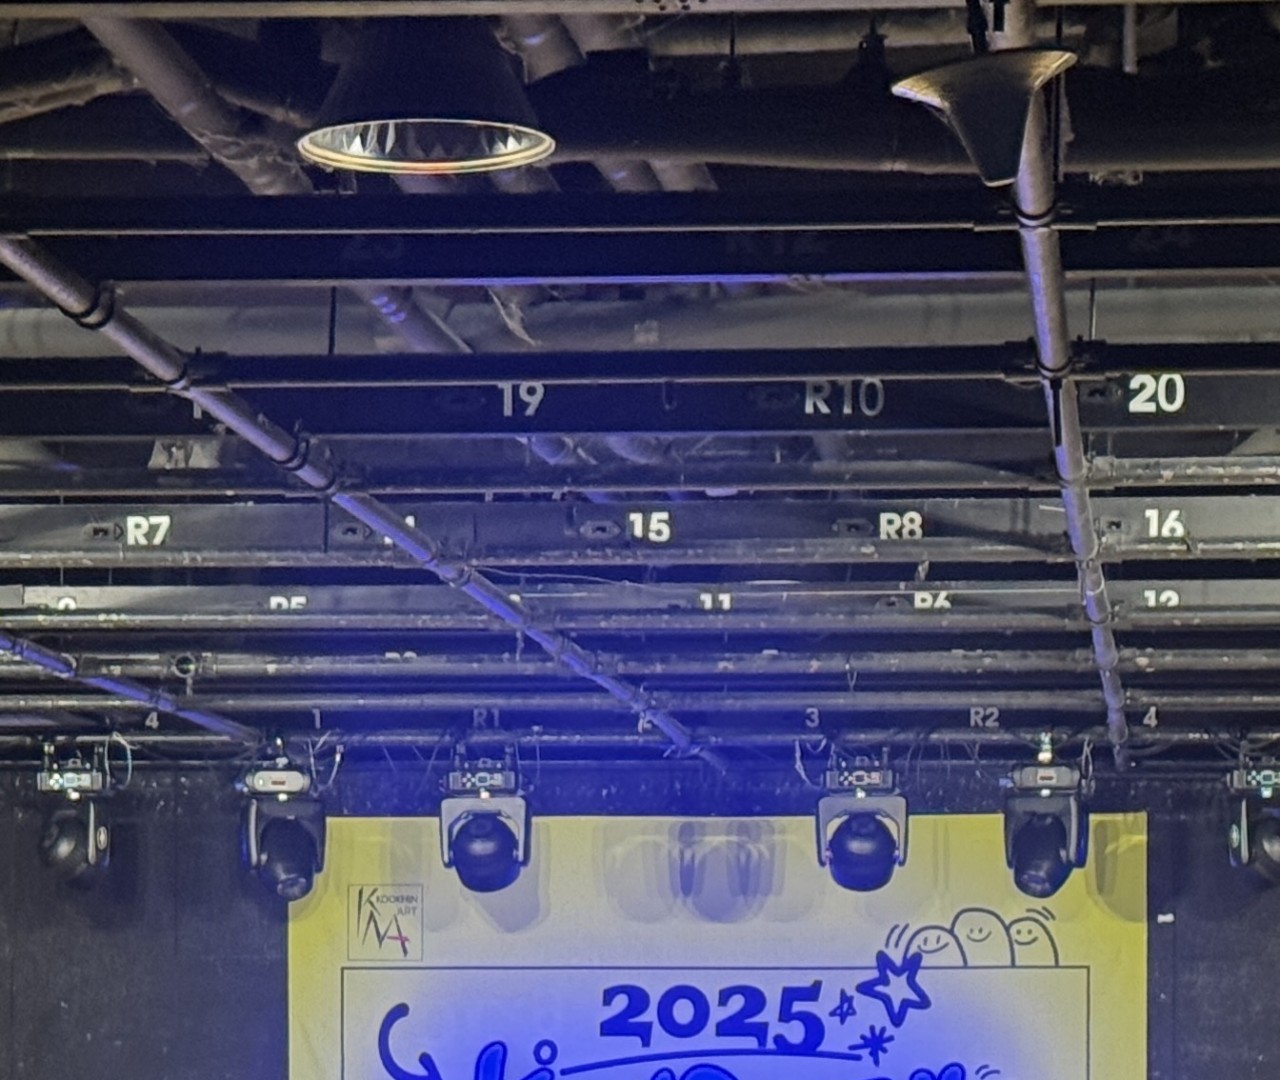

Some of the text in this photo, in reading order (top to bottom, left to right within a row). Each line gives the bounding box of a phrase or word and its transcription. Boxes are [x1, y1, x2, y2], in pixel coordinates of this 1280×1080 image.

[498, 381, 545, 417] 19
[803, 377, 884, 416] R10
[1128, 373, 1185, 413] 20
[126, 515, 170, 546] R7
[629, 511, 671, 542] 15
[879, 511, 923, 539] R8
[1144, 508, 1184, 538] 16
[805, 708, 820, 728] 3
[969, 706, 1000, 728] R2
[1142, 706, 1158, 728] 4
[599, 980, 824, 1051] 2025
